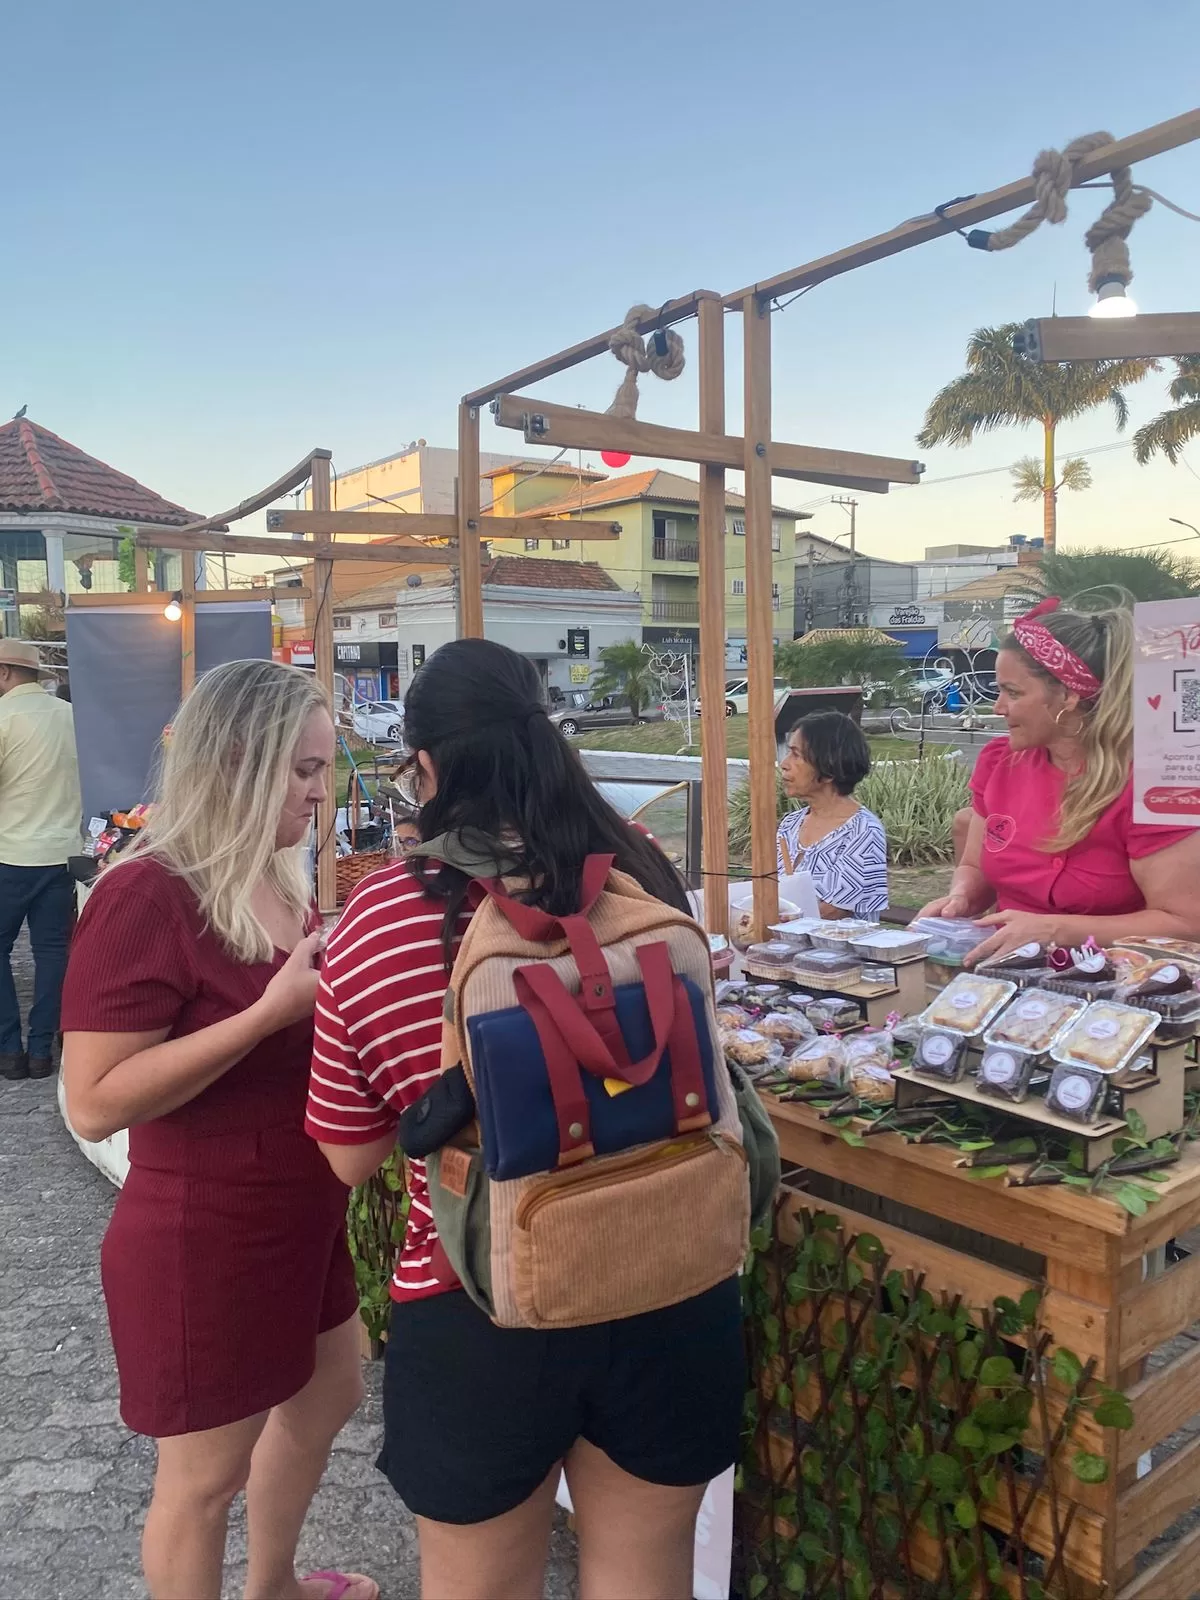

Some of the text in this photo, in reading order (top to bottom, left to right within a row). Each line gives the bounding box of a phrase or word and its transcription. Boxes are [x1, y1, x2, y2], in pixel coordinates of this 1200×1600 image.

[895, 606, 919, 617] Varejão
[889, 616, 925, 624] das Fraldas
[1163, 754, 1195, 762] Aponte
[1165, 764, 1185, 773] para
